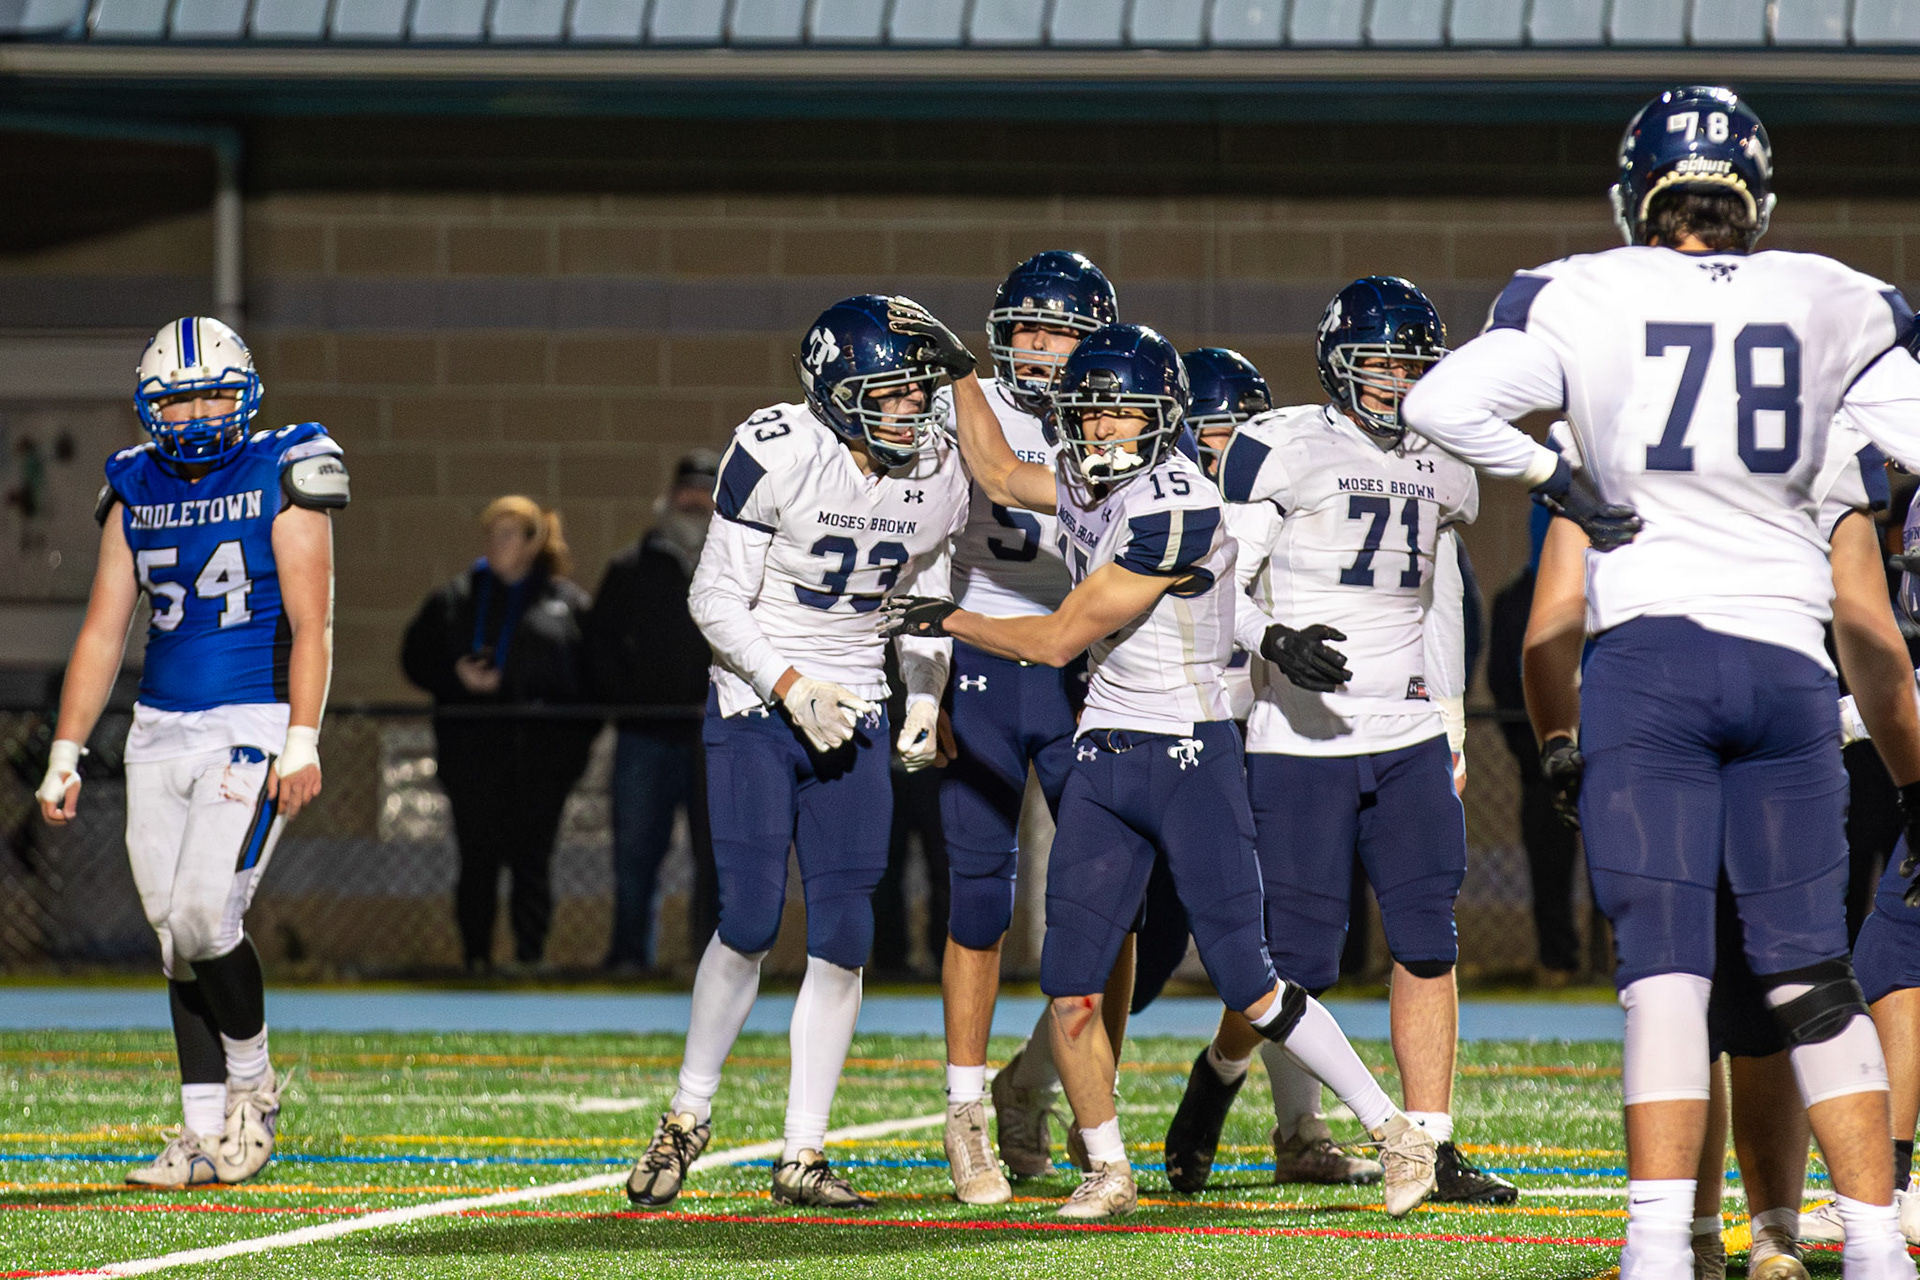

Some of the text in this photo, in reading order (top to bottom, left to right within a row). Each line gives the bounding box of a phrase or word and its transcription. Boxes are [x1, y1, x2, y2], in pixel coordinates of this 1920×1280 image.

[1666, 111, 1730, 144] 78
[1645, 320, 1804, 474] 78
[747, 409, 792, 443] 33
[1011, 449, 1046, 465] SES
[1149, 471, 1191, 500] 15
[1338, 477, 1436, 499] MOSES BROWN
[130, 489, 264, 530] IDDLETOWN
[817, 511, 918, 535] MOSES BROWN
[1339, 494, 1424, 588] 71
[136, 539, 253, 632] 54
[793, 534, 910, 614] 33
